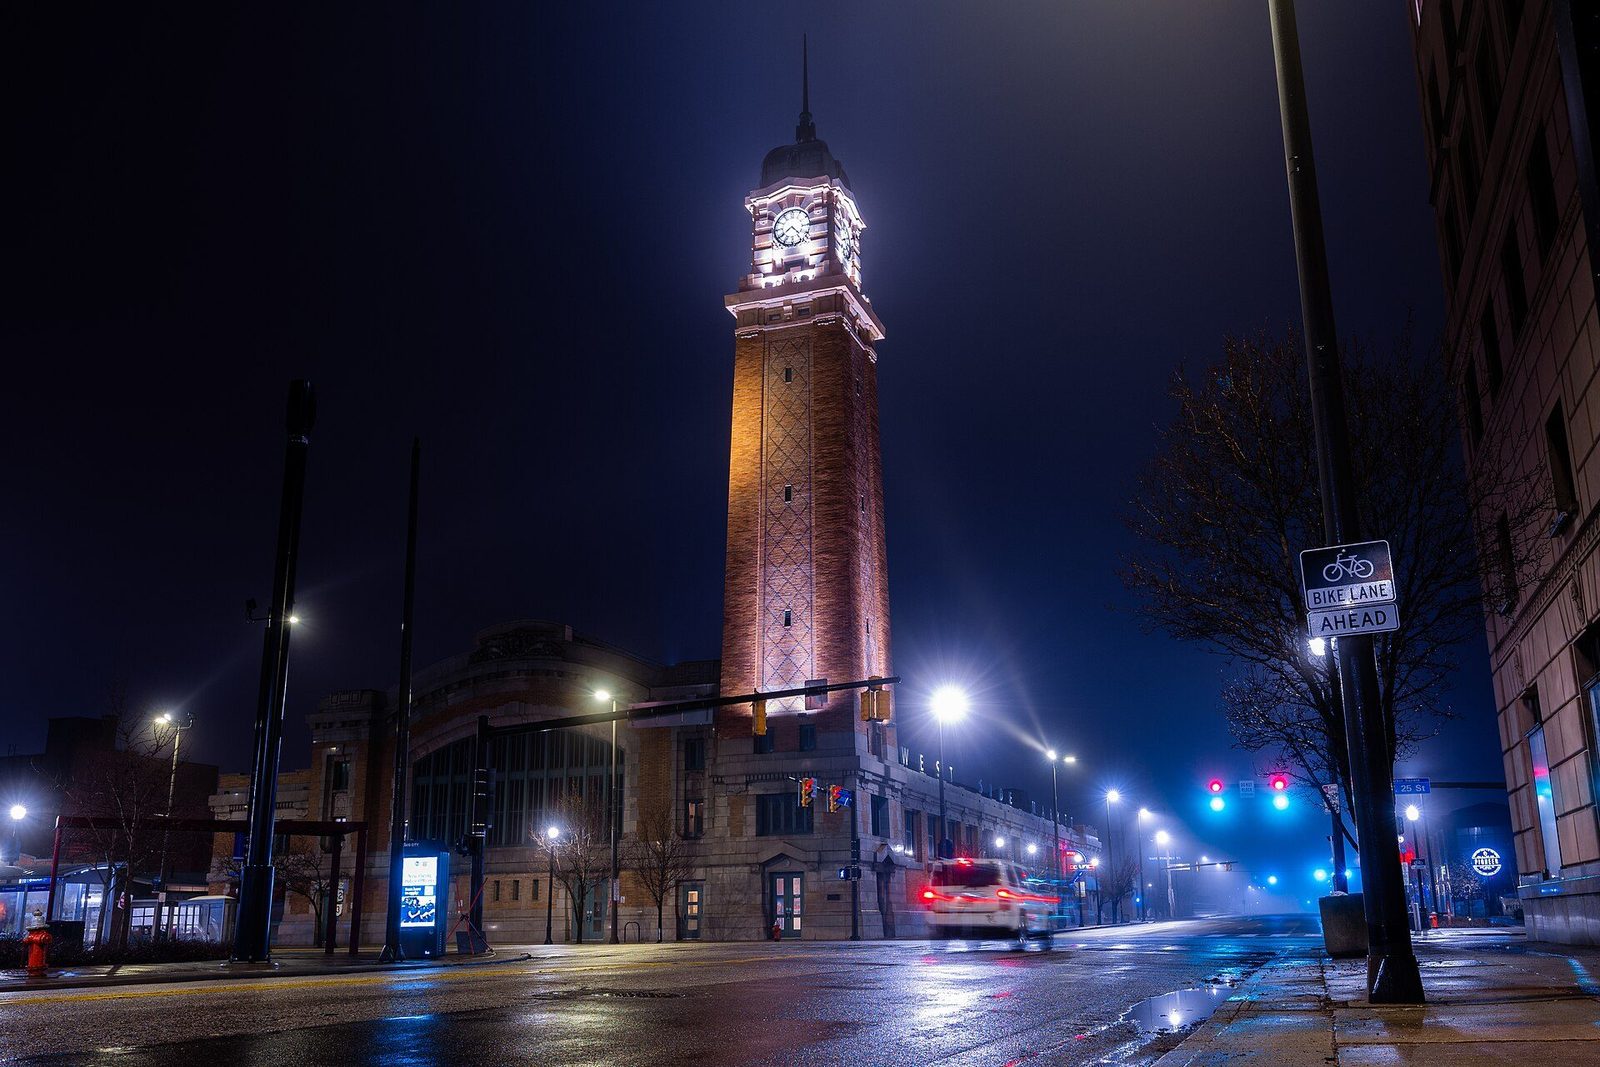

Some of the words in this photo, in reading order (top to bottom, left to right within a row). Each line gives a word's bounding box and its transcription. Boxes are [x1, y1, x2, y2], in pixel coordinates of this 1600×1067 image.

[1313, 589, 1345, 605] BIKE
[1350, 583, 1388, 601] LANE
[1321, 610, 1387, 632] AHEAD
[901, 746, 953, 783] WEST
[1400, 784, 1412, 793] 25
[1415, 783, 1426, 793] St
